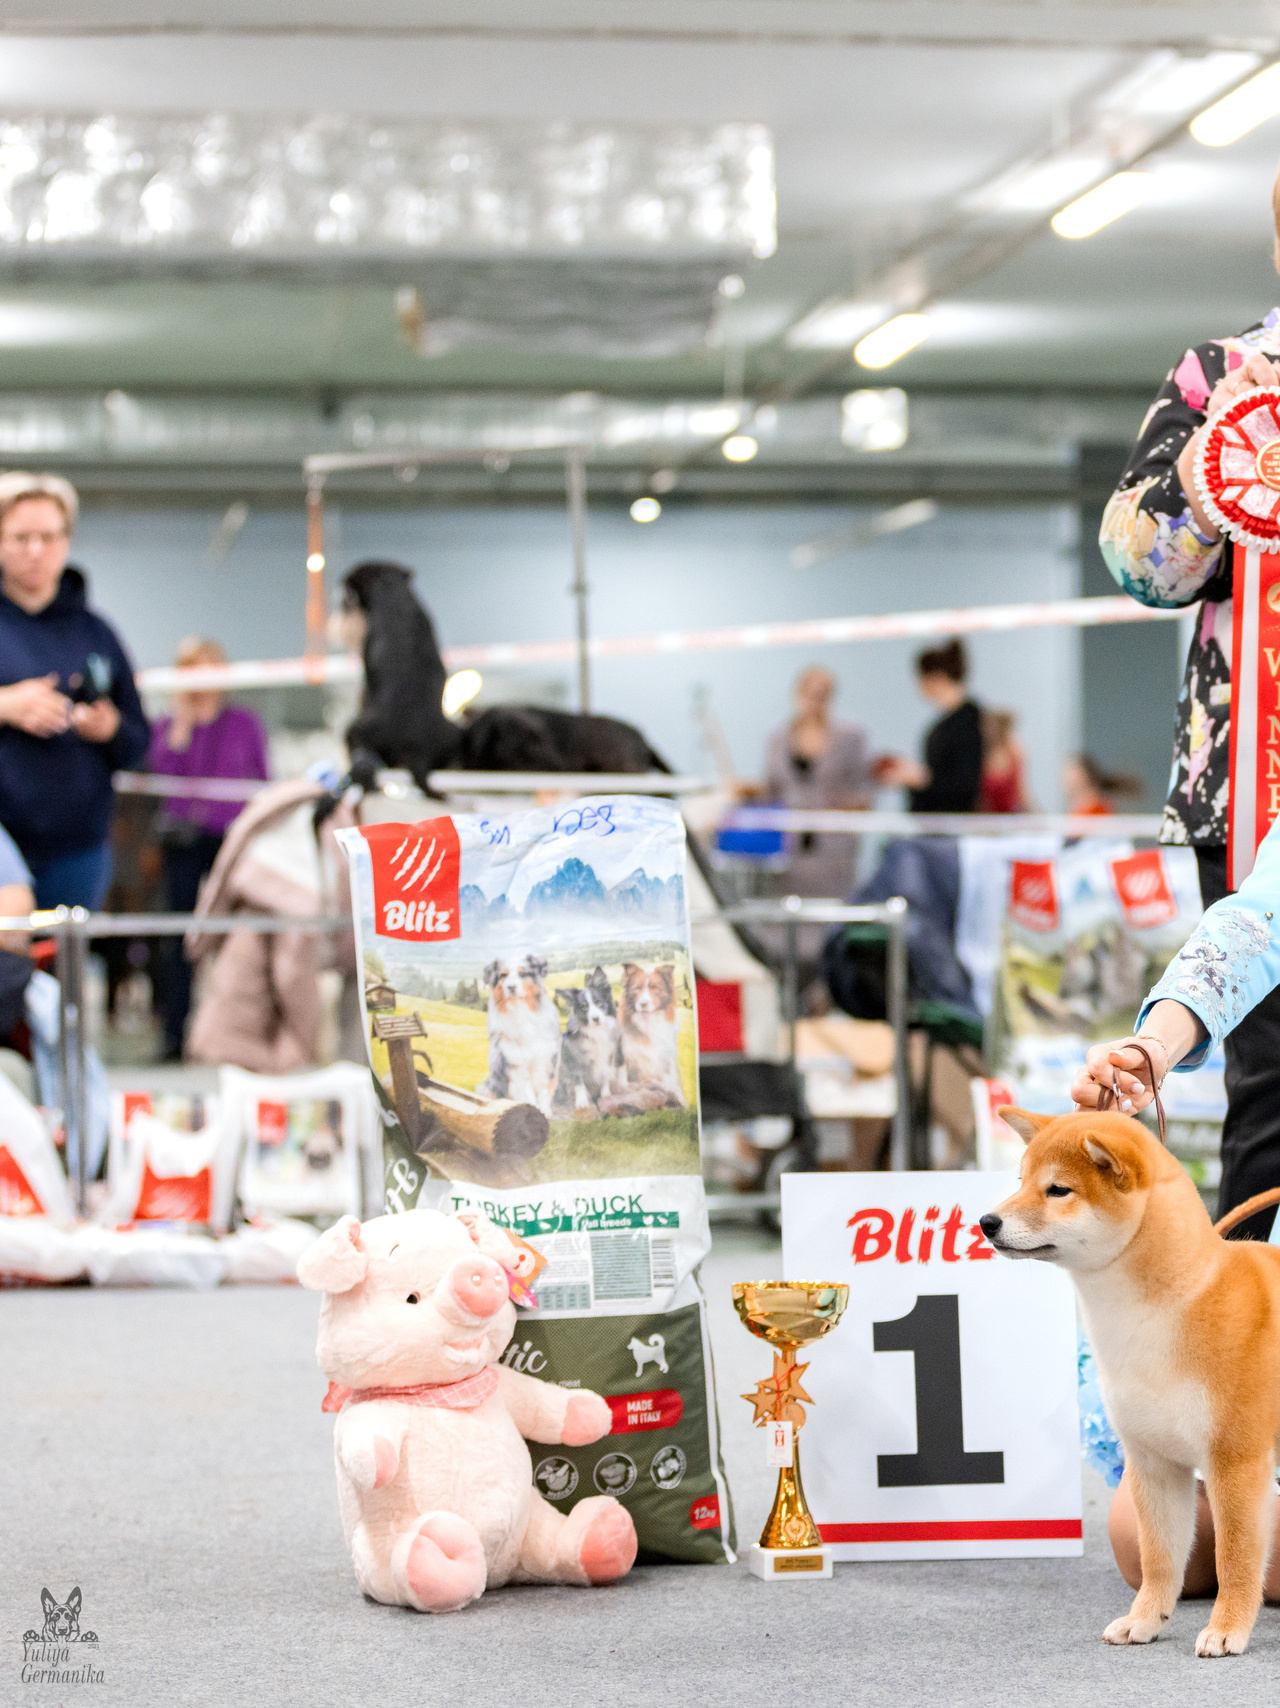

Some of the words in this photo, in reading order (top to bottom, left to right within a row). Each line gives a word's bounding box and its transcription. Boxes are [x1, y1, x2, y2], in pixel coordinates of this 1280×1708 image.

[383, 900, 451, 933] Blitz
[846, 1203, 998, 1267] Blitz
[627, 1399, 653, 1413] MADE
[872, 1293, 1005, 1488] 1
[628, 1413, 638, 1425] IN
[640, 1411, 661, 1424] ITALY
